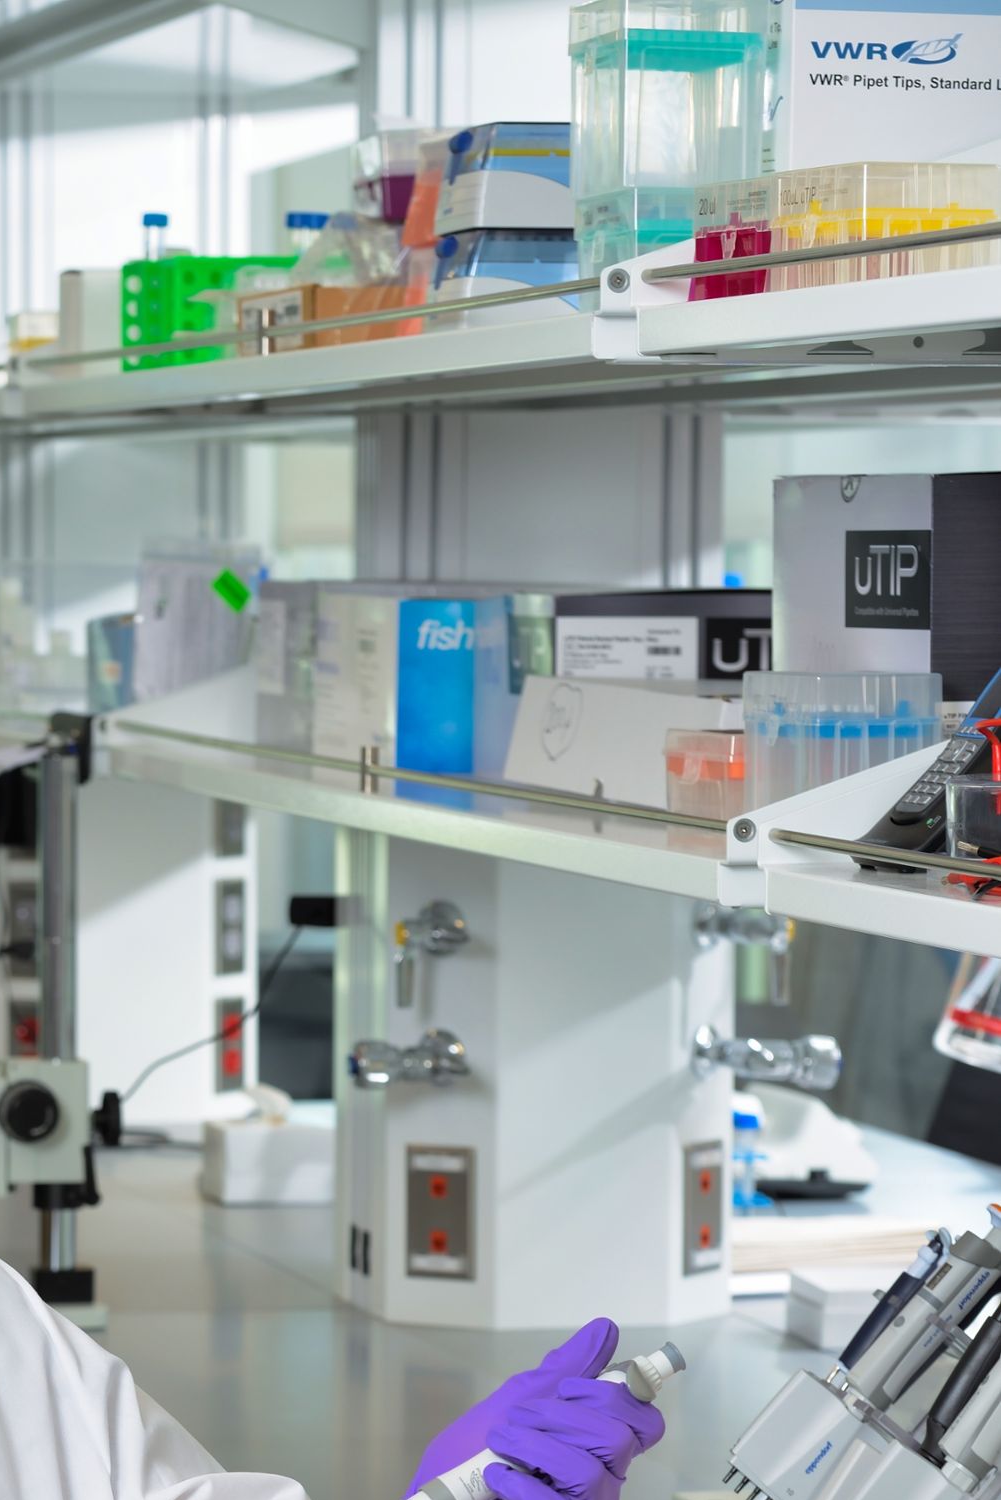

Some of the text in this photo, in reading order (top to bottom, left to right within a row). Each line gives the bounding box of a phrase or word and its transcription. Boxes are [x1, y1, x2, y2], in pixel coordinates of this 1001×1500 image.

[811, 41, 887, 61] VWR
[853, 75, 889, 90] Pipet
[892, 76, 925, 91] Tips,
[930, 77, 992, 91] Standard
[699, 199, 708, 216] 20
[959, 1271, 990, 1310] eppendorf
[805, 1441, 833, 1475] eppendorf
